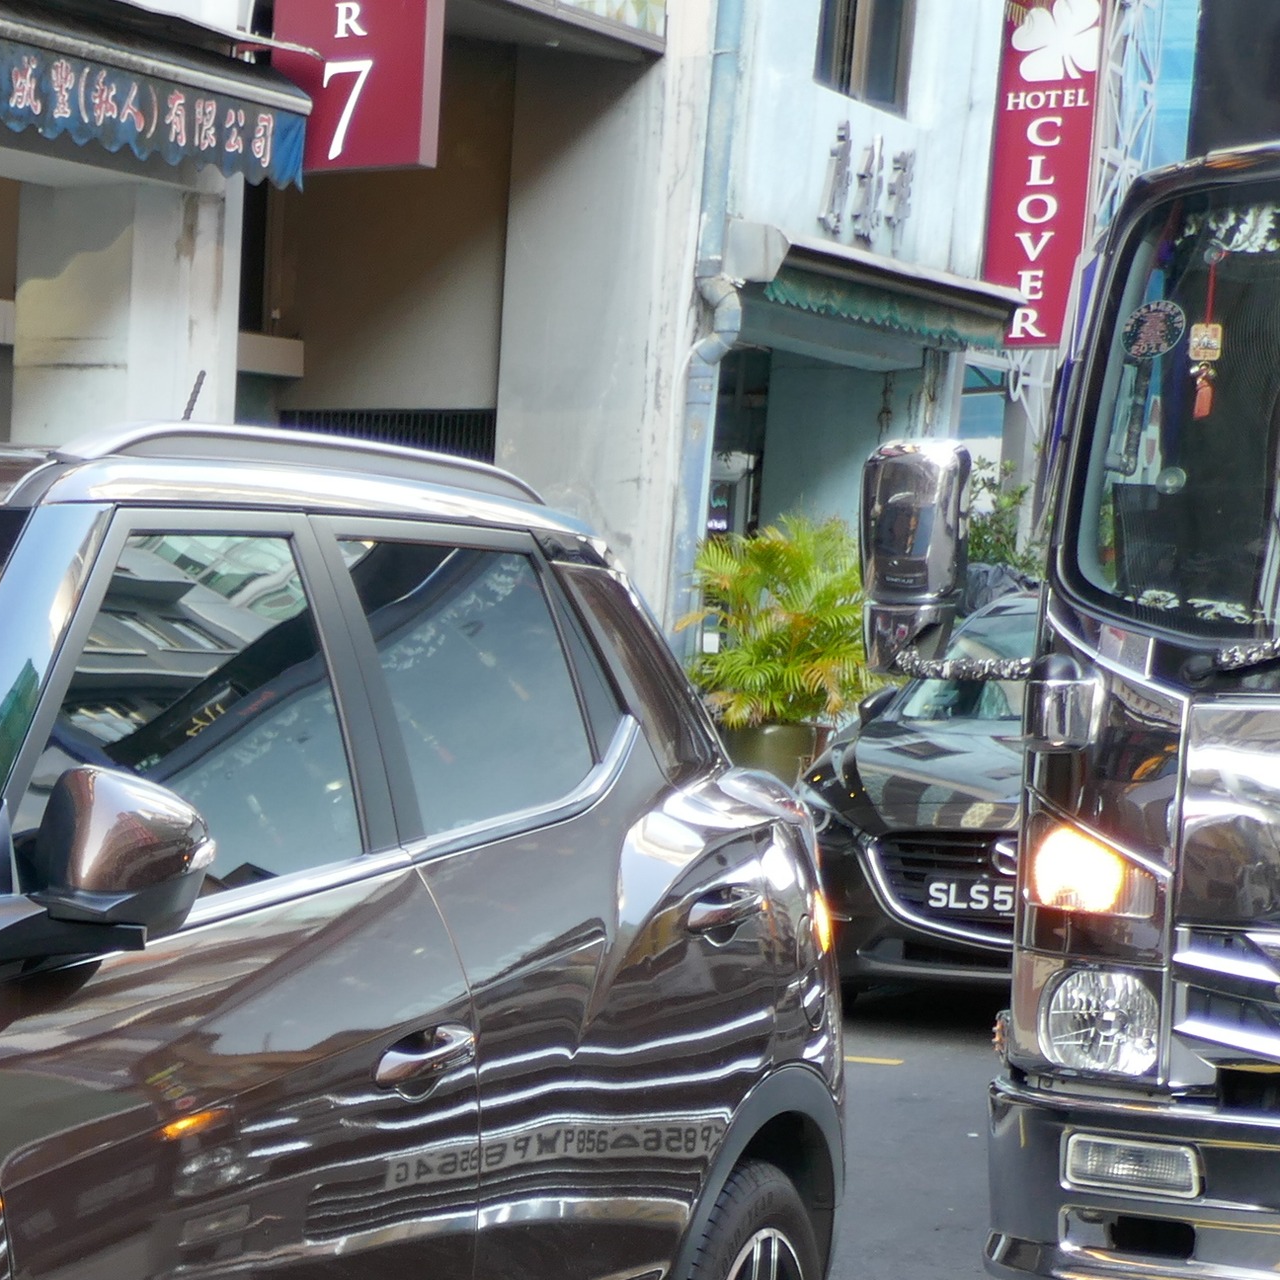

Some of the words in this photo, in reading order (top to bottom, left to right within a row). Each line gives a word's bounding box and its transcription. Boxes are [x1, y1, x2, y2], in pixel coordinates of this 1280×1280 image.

[323, 59, 374, 161] 7
[1005, 88, 1090, 111] HOTEL
[1008, 116, 1063, 339] CLOVER
